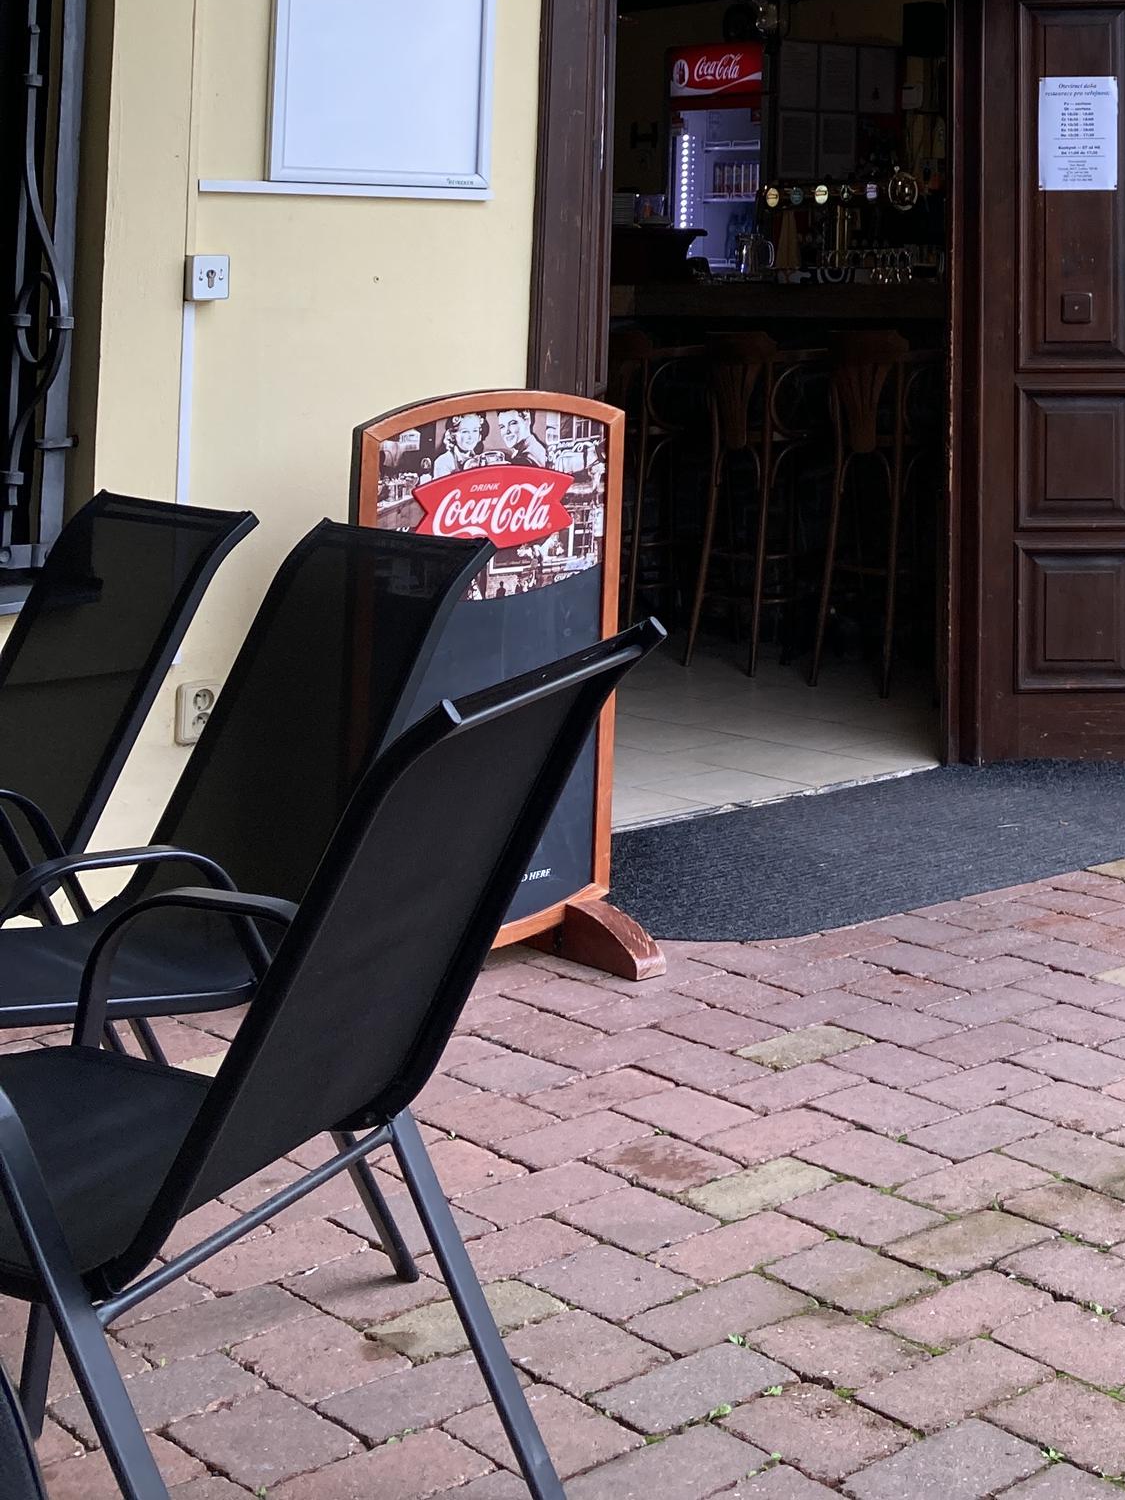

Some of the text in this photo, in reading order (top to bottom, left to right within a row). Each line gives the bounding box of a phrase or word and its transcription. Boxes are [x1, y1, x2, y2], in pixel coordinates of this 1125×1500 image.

[469, 482, 501, 492] DRINK
[432, 481, 556, 536] Coca-Cola
[529, 867, 552, 881] HERE
